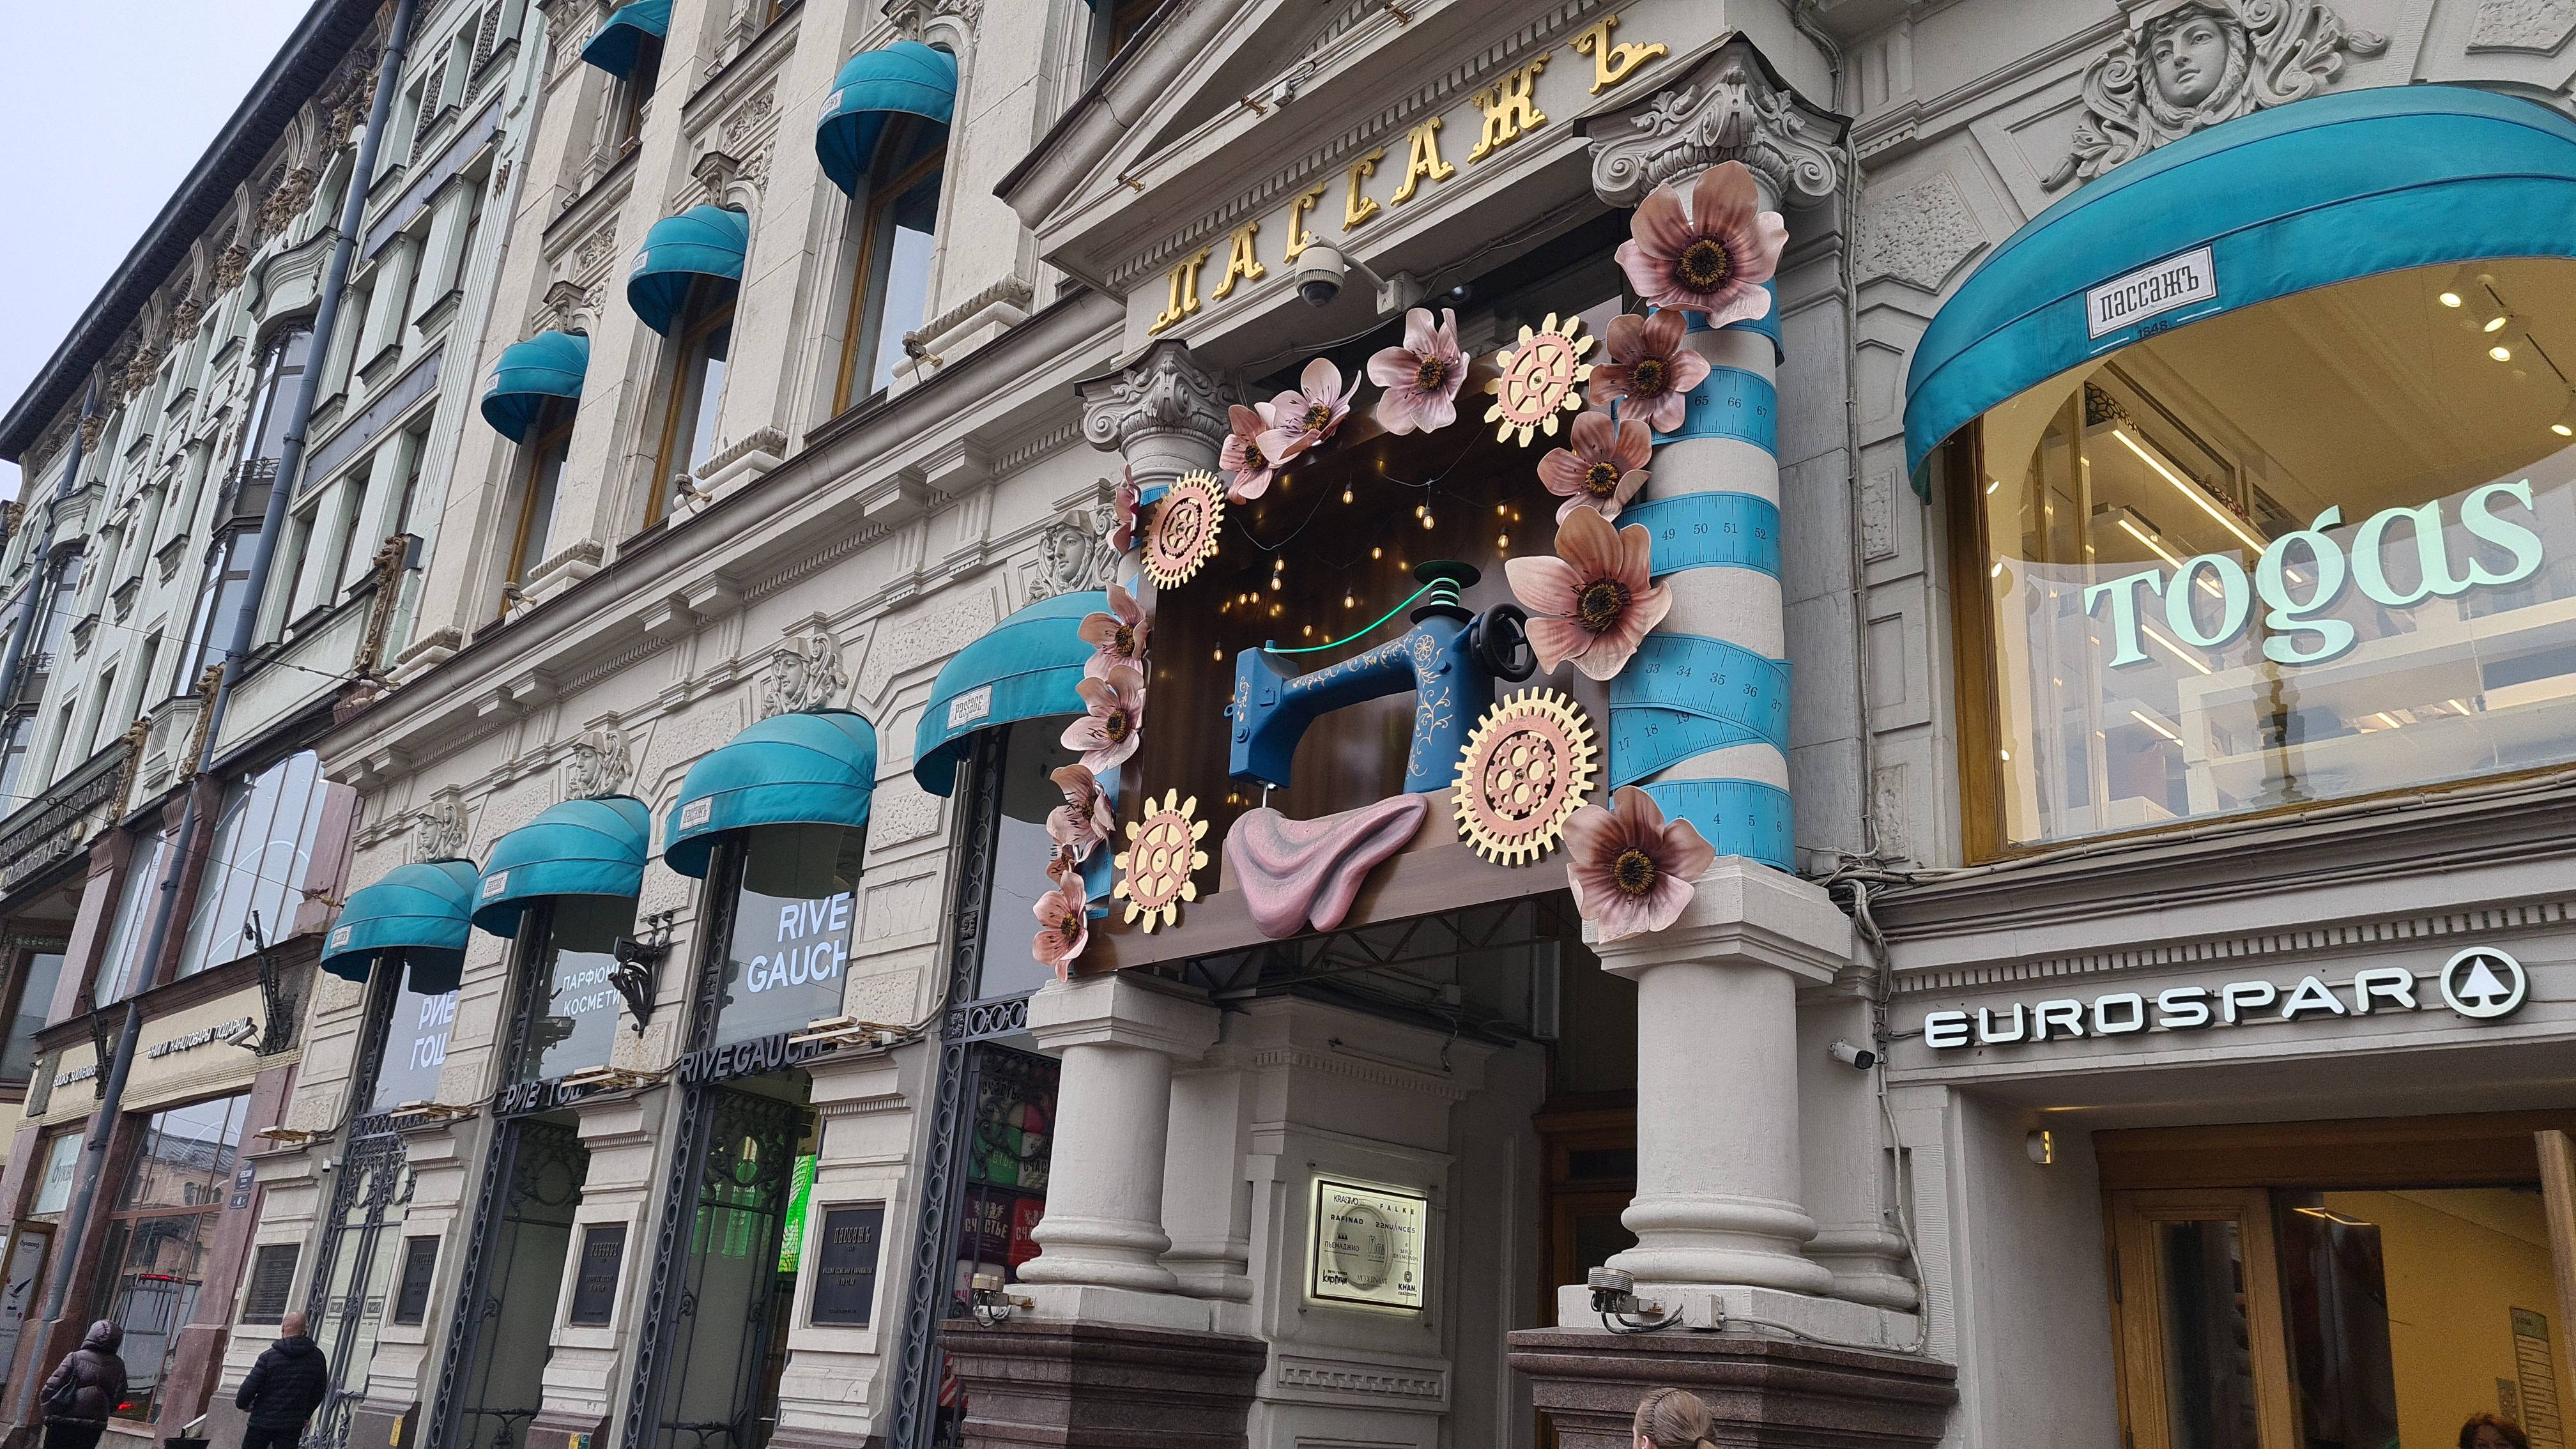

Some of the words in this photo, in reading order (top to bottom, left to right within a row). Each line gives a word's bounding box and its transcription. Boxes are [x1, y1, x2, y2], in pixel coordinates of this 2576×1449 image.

[1149, 14, 1669, 335] ПАССАЖЪ
[2136, 320, 2168, 338] 1848
[1694, 395, 1709, 406] 65
[1728, 397, 1742, 408] 66
[1756, 406, 1767, 418] 67
[1662, 528, 1676, 540] 49
[1693, 523, 1708, 535] 50
[1723, 522, 1738, 534] 51
[1754, 528, 1767, 540] 52
[1645, 663, 1660, 674] 33
[1676, 665, 1692, 677] 34
[1710, 672, 1726, 686] 35
[1742, 683, 1758, 697] 36
[1771, 698, 1782, 713] 37
[1618, 736, 1629, 751] 17
[1644, 723, 1659, 738] 18
[1675, 712, 1690, 725] 19
[1713, 813, 1721, 825] 4
[1748, 815, 1756, 827] 5
[1776, 821, 1782, 833] 6
[777, 891, 850, 943] RIVE
[563, 988, 622, 1017] КОСМЕТИ
[1924, 966, 2419, 1050] EUROSPAR
[169, 1027, 215, 1053] КАНЦТОВАРЫ
[1330, 1214, 1364, 1225] RAFINAD
[1379, 1203, 1414, 1215] FALKE
[965, 1218, 1009, 1239] СЧСТЬЕ
